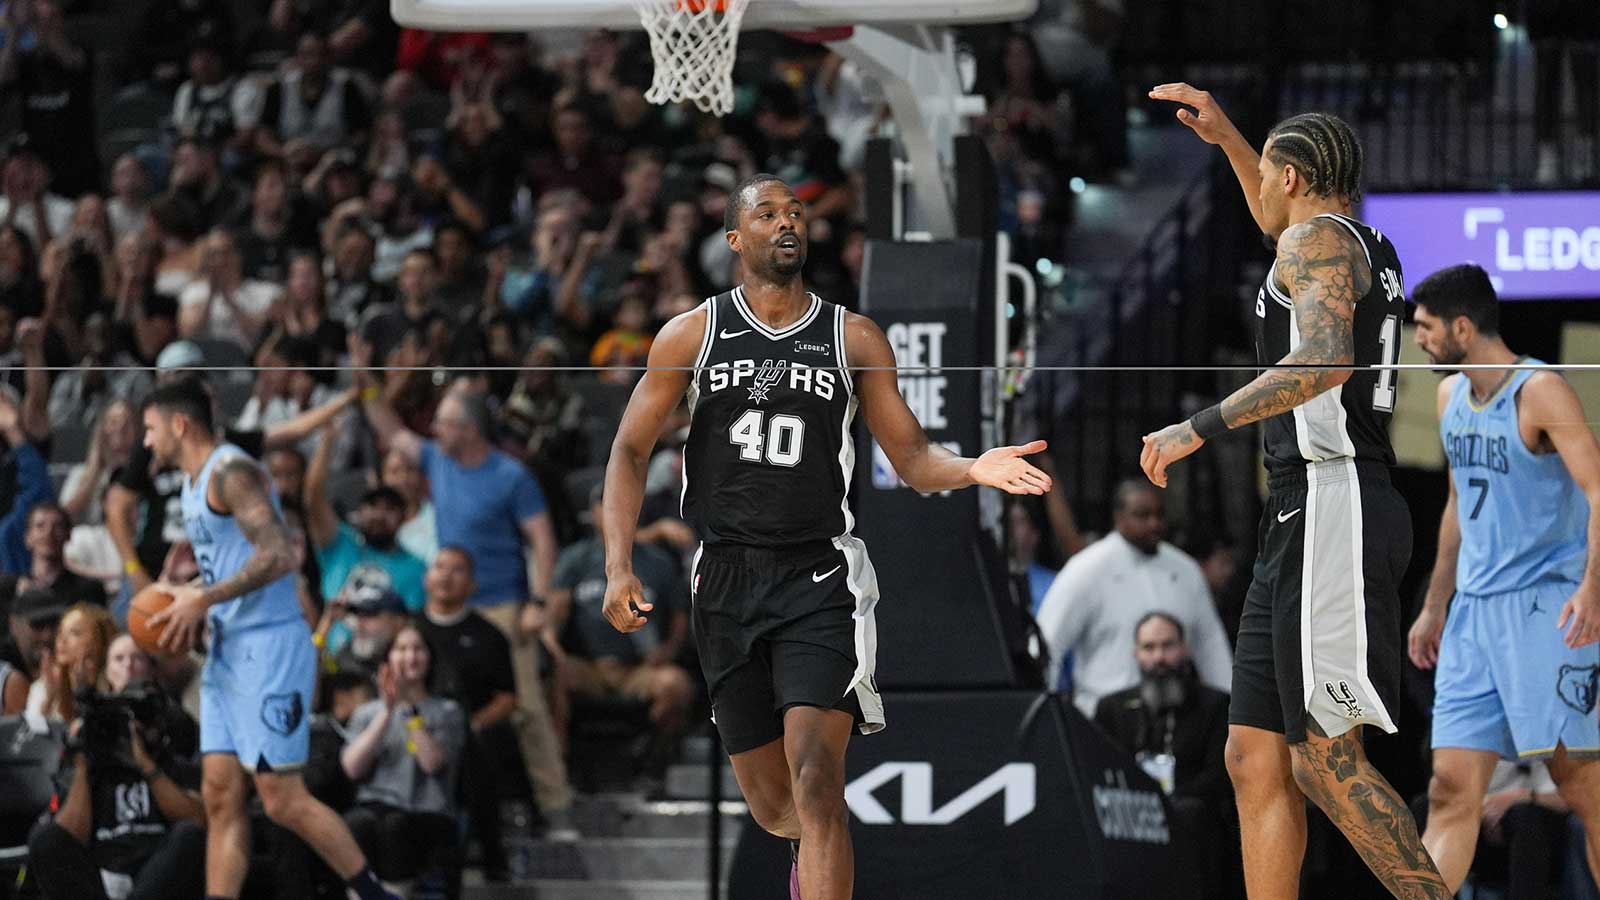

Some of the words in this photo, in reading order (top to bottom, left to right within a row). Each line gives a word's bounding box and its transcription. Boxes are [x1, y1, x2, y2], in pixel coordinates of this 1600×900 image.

[799, 343, 825, 352] LEDGER
[886, 322, 947, 375] GET
[1372, 313, 1402, 412] 1
[709, 359, 836, 403] SPURS
[729, 409, 805, 467] 40
[1446, 431, 1509, 474] GRIZZLIES
[1469, 477, 1489, 520] 7
